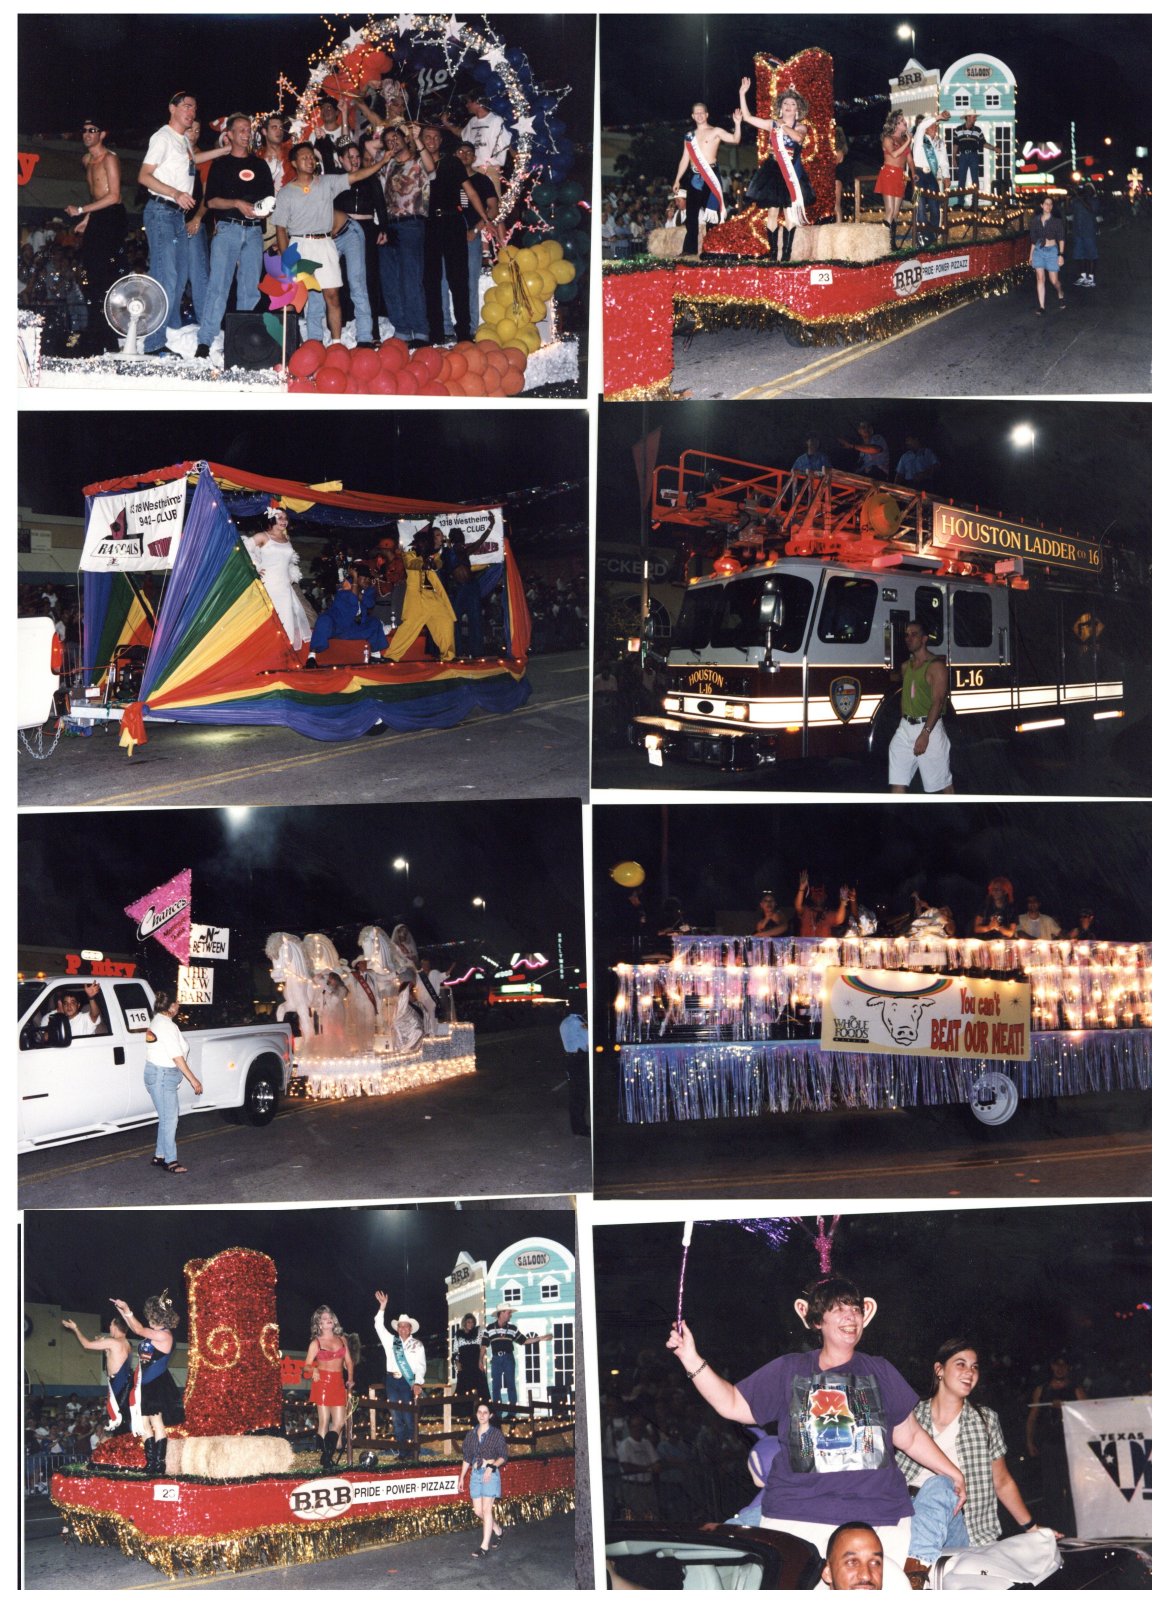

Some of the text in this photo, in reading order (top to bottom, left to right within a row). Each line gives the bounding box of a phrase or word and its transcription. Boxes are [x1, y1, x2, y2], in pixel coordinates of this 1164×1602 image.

[897, 72, 922, 86] BRB
[966, 67, 990, 77] SALOON
[922, 259, 968, 276] PRIDE POWER PIZZAZZ
[818, 273, 830, 283] 23
[894, 266, 923, 289] BRB
[439, 518, 453, 527] 1318
[942, 515, 1021, 550] HOUSTON
[1024, 534, 1076, 561] LADDER
[1088, 550, 1100, 566] 16
[688, 669, 724, 688] HOUSTON
[956, 669, 984, 688] L-16
[699, 682, 713, 694] L-16
[140, 896, 188, 937] Chances
[65, 953, 137, 979] Pntry
[186, 965, 208, 979] THE
[183, 978, 210, 990] NEW
[180, 990, 212, 1003] BARN
[960, 987, 1001, 1017] You can't
[130, 1012, 147, 1023] 116
[833, 1015, 870, 1030] WHOLE
[835, 1028, 869, 1039] FOODS
[931, 1018, 1025, 1056] BEAT OUR MEAT!
[517, 1253, 548, 1267] SALOON
[451, 1266, 470, 1284] BRB
[1099, 1432, 1145, 1442] TEXAS
[354, 1480, 455, 1498] PRIDE POWER PIZZAZZ
[292, 1486, 352, 1512] BRB
